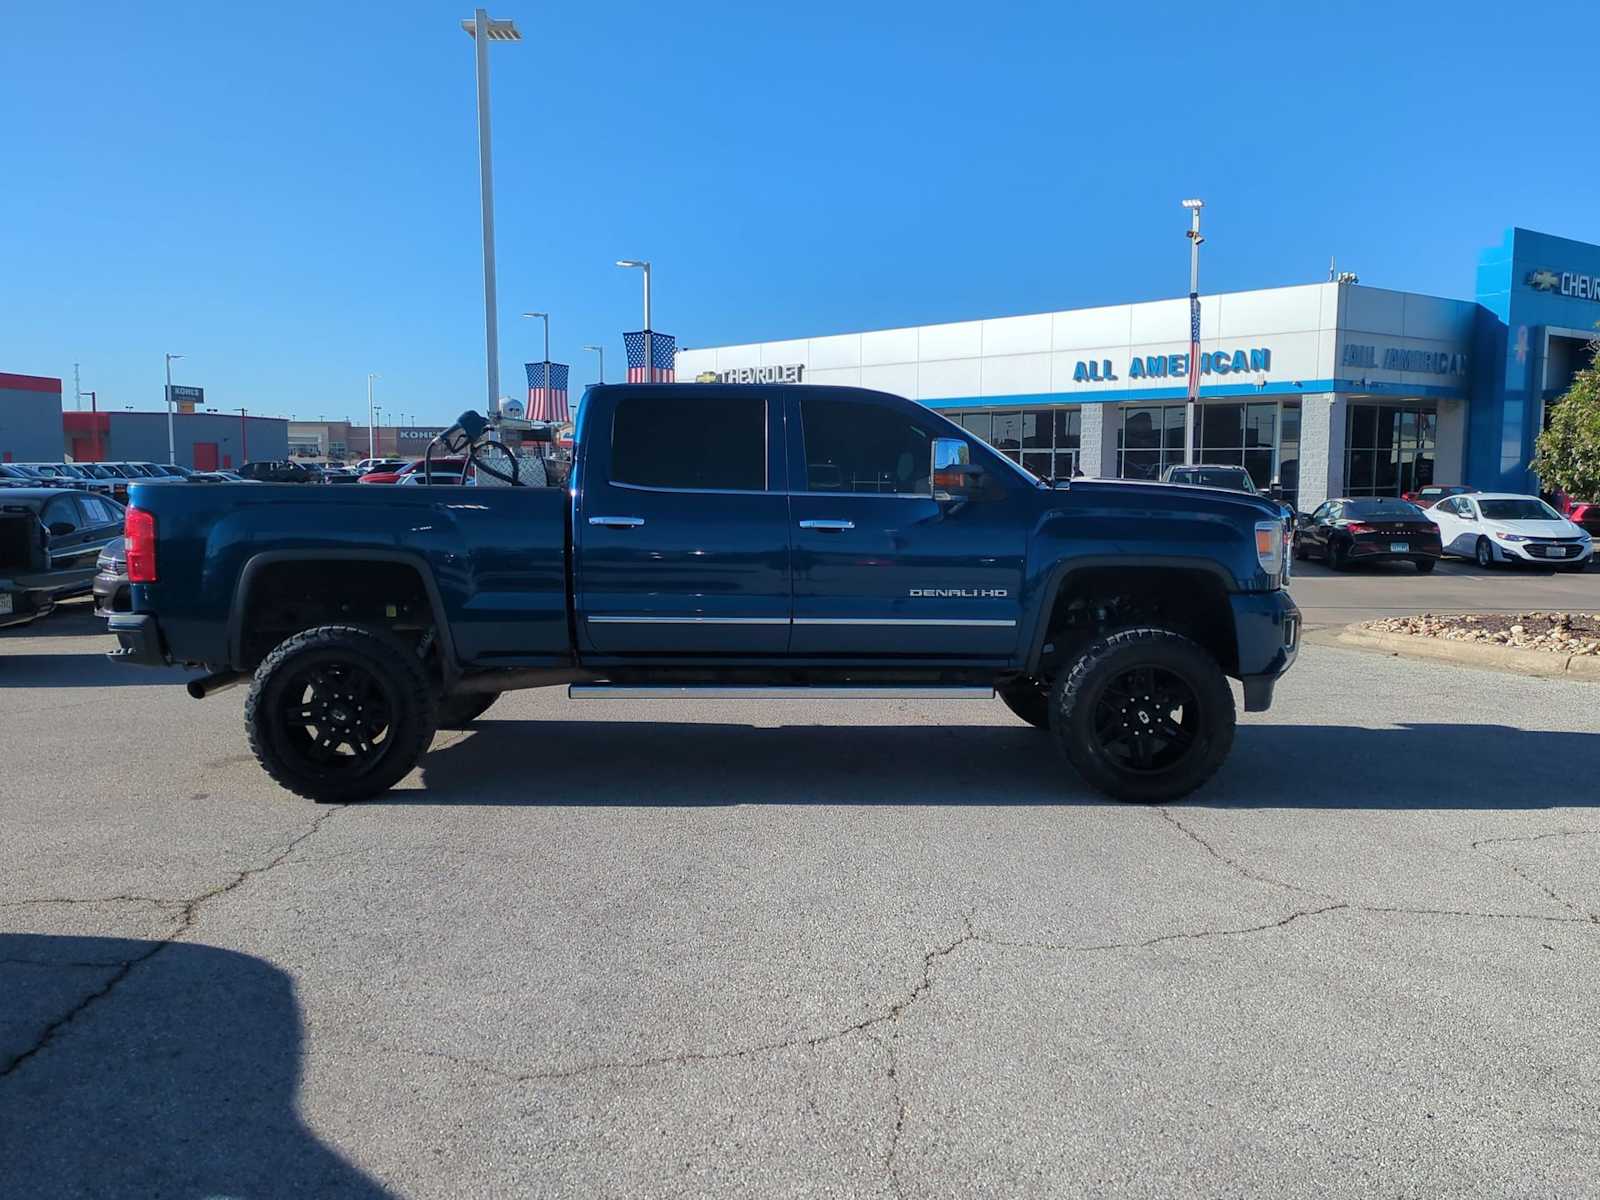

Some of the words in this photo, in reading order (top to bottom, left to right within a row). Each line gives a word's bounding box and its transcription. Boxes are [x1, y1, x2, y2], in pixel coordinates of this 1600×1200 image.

[721, 363, 805, 384] CHEVROLET
[1073, 360, 1118, 382] ALL
[1129, 348, 1271, 379] AMEICAN
[909, 589, 978, 597] DENALI
[981, 589, 1008, 597] HD
